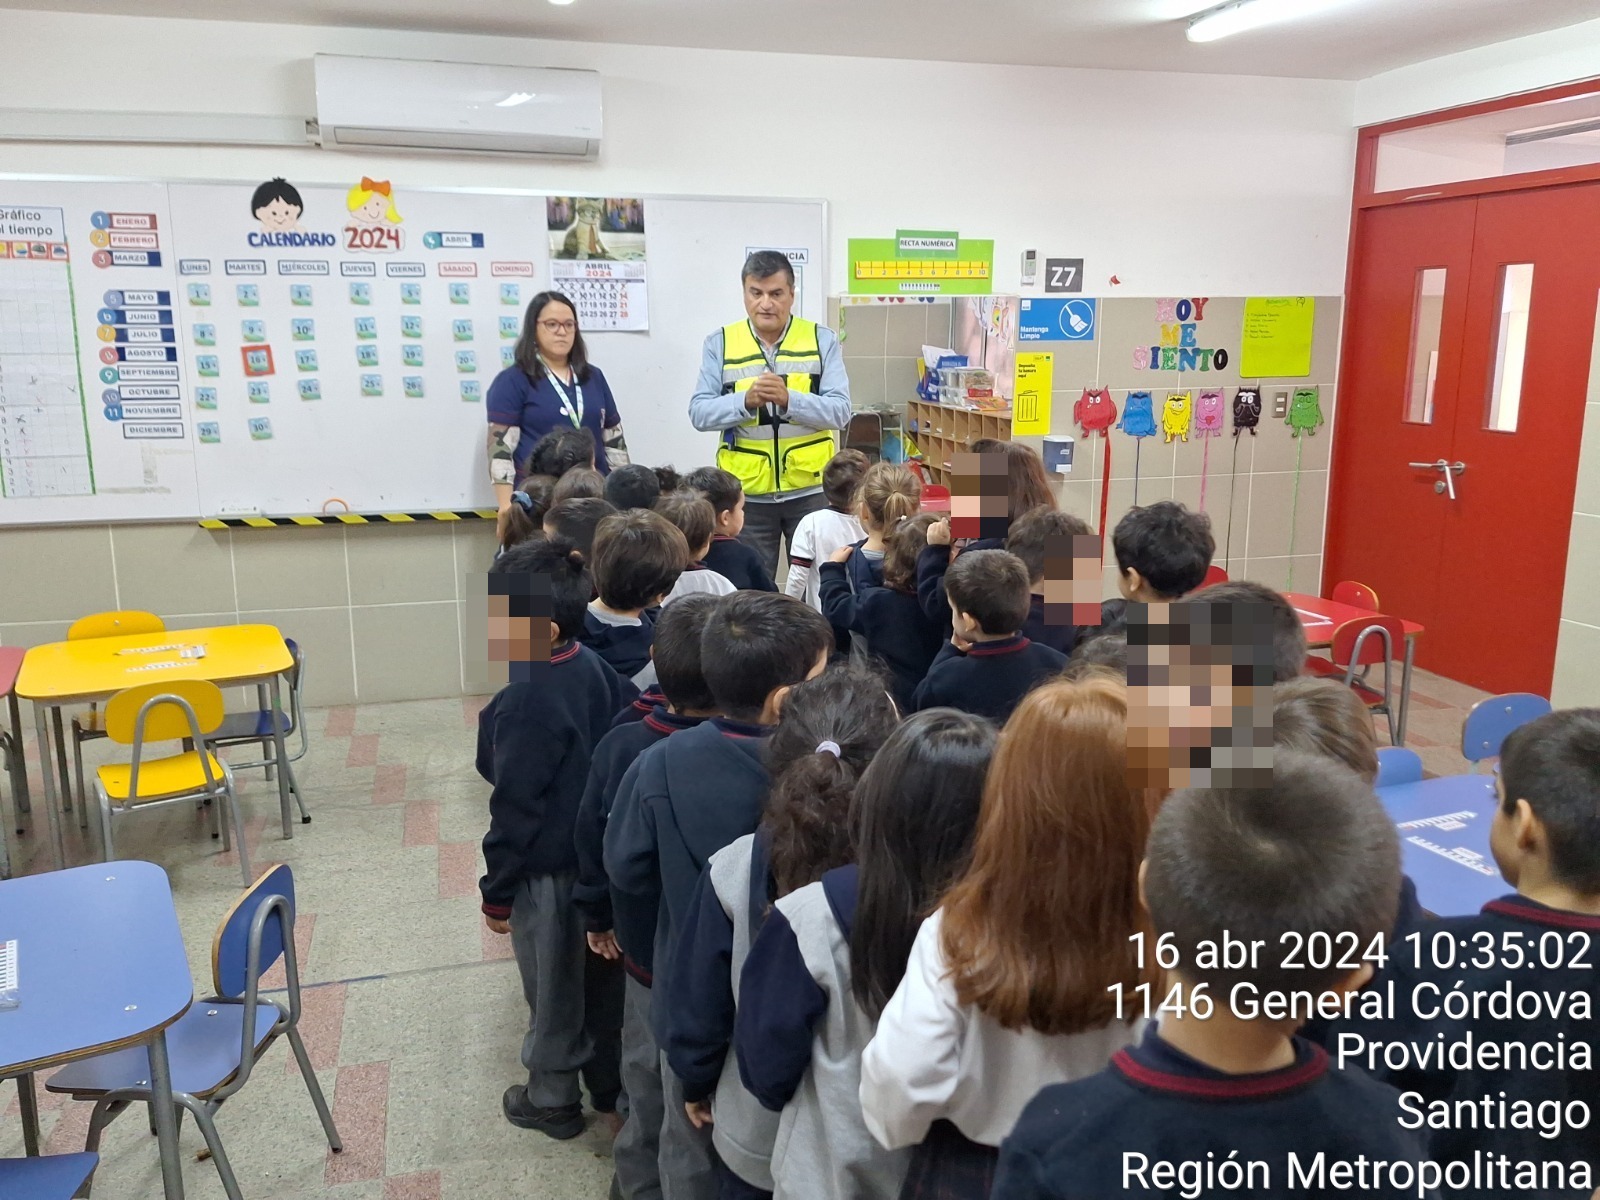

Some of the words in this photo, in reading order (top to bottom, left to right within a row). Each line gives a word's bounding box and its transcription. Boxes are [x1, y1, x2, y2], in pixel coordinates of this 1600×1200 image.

[9, 224, 53, 238] tiempo
[247, 231, 336, 248] CALENDARIO
[344, 226, 402, 249] 2024
[921, 239, 954, 248] NUMÉRICA
[114, 254, 146, 262] MARZO
[182, 264, 208, 272] LUNES
[228, 263, 262, 272] MARTES
[281, 262, 327, 272] MIÉRCOLES
[344, 265, 373, 273] JUEVES
[442, 264, 473, 273] SÁBADO
[494, 265, 530, 273] DOMINGO
[1050, 266, 1076, 287] Z7
[127, 293, 154, 301] MAYO
[1155, 297, 1209, 322] HOY
[1020, 326, 1049, 334] Mantenga
[1159, 323, 1197, 347] ME
[127, 349, 164, 357] AGOSTO
[1133, 345, 1229, 372] SIENTO
[128, 388, 171, 396] OCTUBRE
[129, 426, 178, 434] DICIEMBRE
